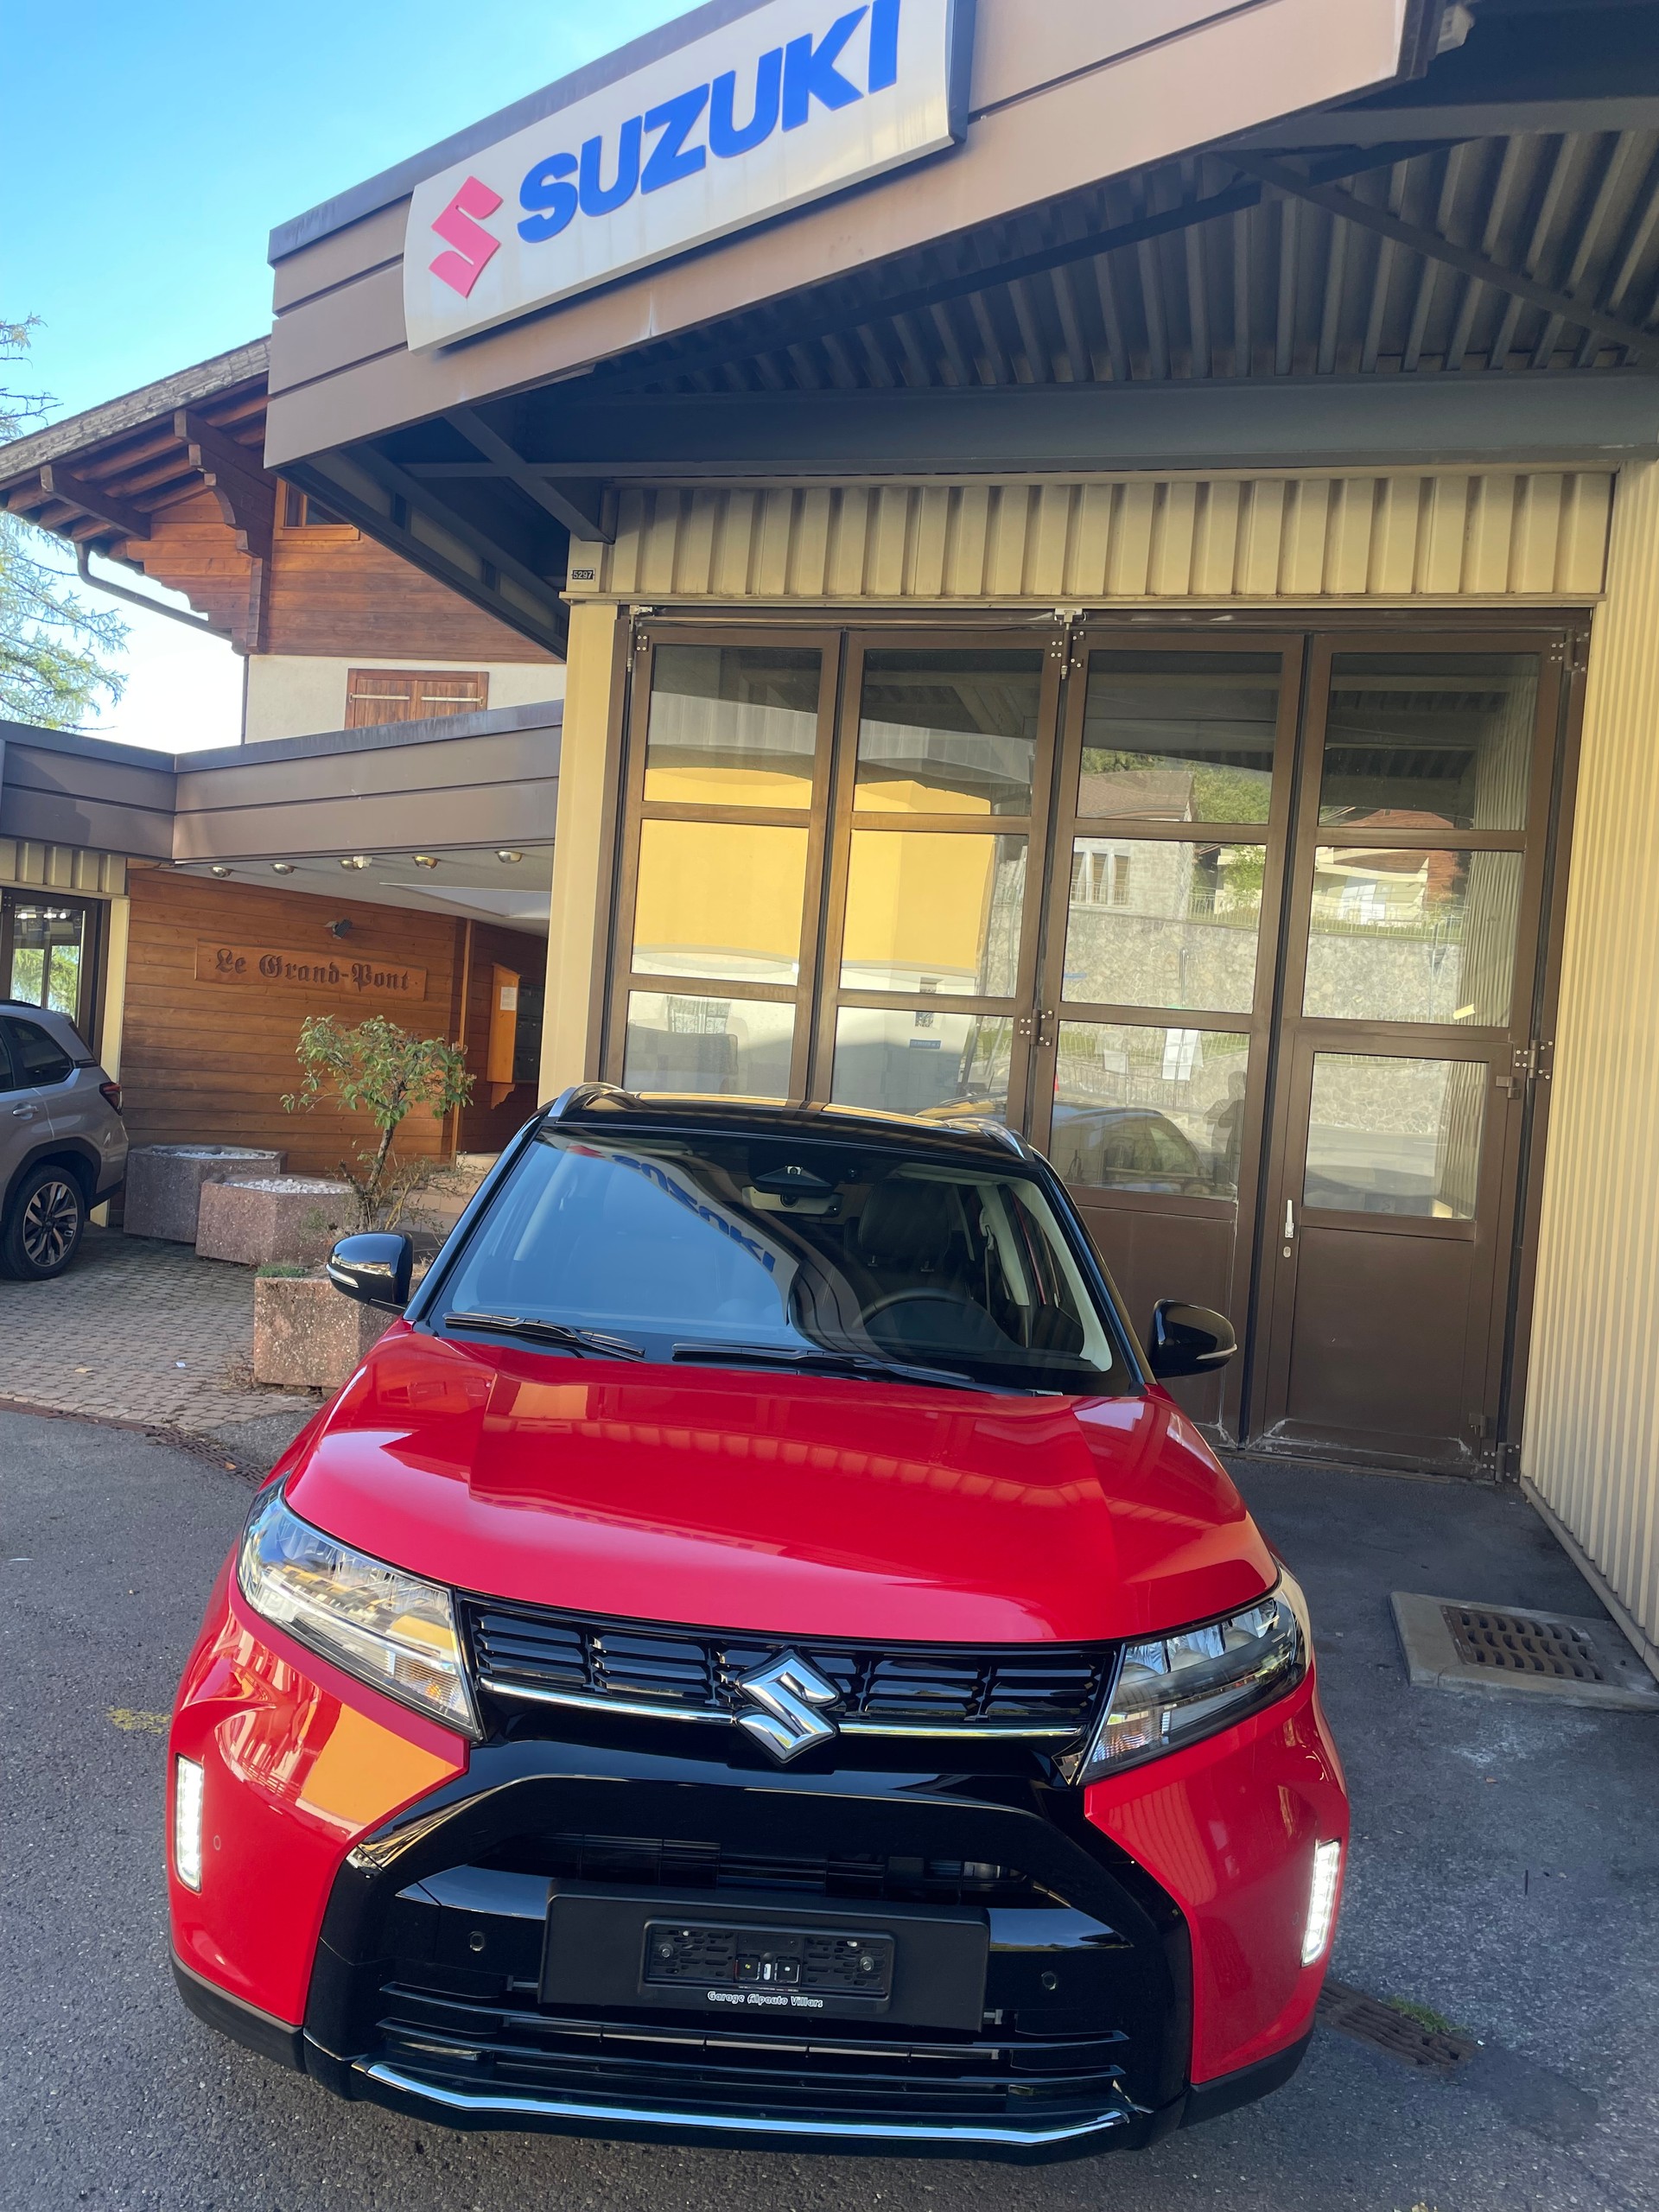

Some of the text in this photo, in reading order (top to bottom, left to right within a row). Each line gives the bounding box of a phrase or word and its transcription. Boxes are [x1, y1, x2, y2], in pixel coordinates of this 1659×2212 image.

[517, 0, 899, 243] SUZUKI
[573, 570, 593, 579] 5297
[215, 948, 410, 991] Le Grand-Pont
[708, 1991, 823, 2008] Garage Alpauto Villars
